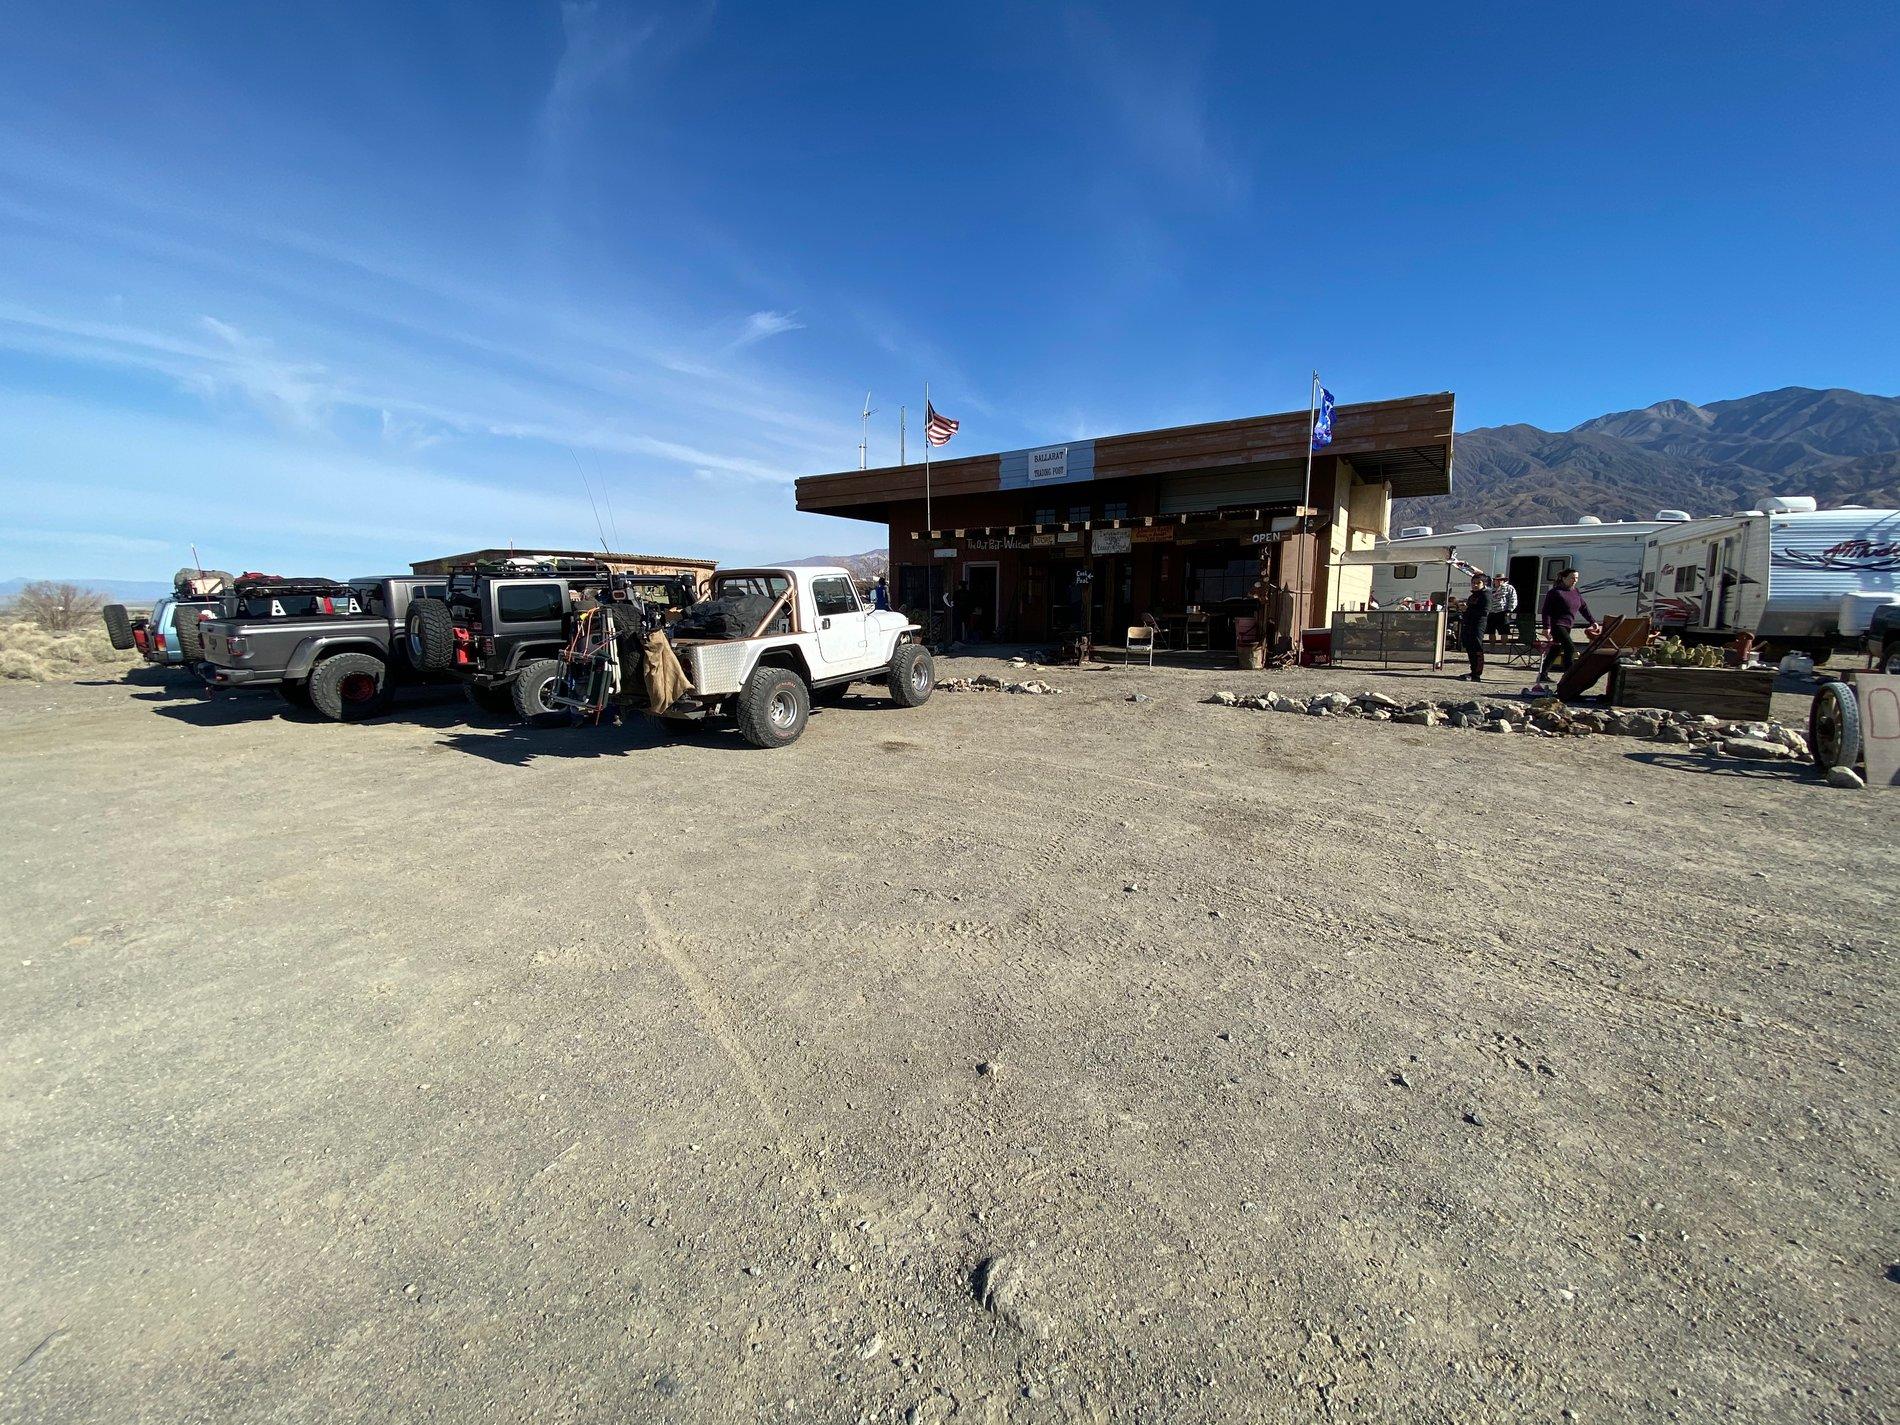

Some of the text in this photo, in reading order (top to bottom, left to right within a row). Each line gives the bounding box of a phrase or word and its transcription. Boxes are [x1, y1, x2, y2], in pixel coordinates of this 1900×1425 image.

[1034, 452, 1064, 463] BALLARAT
[1034, 466, 1064, 477] TRADING POST
[1252, 532, 1281, 543] OPEN
